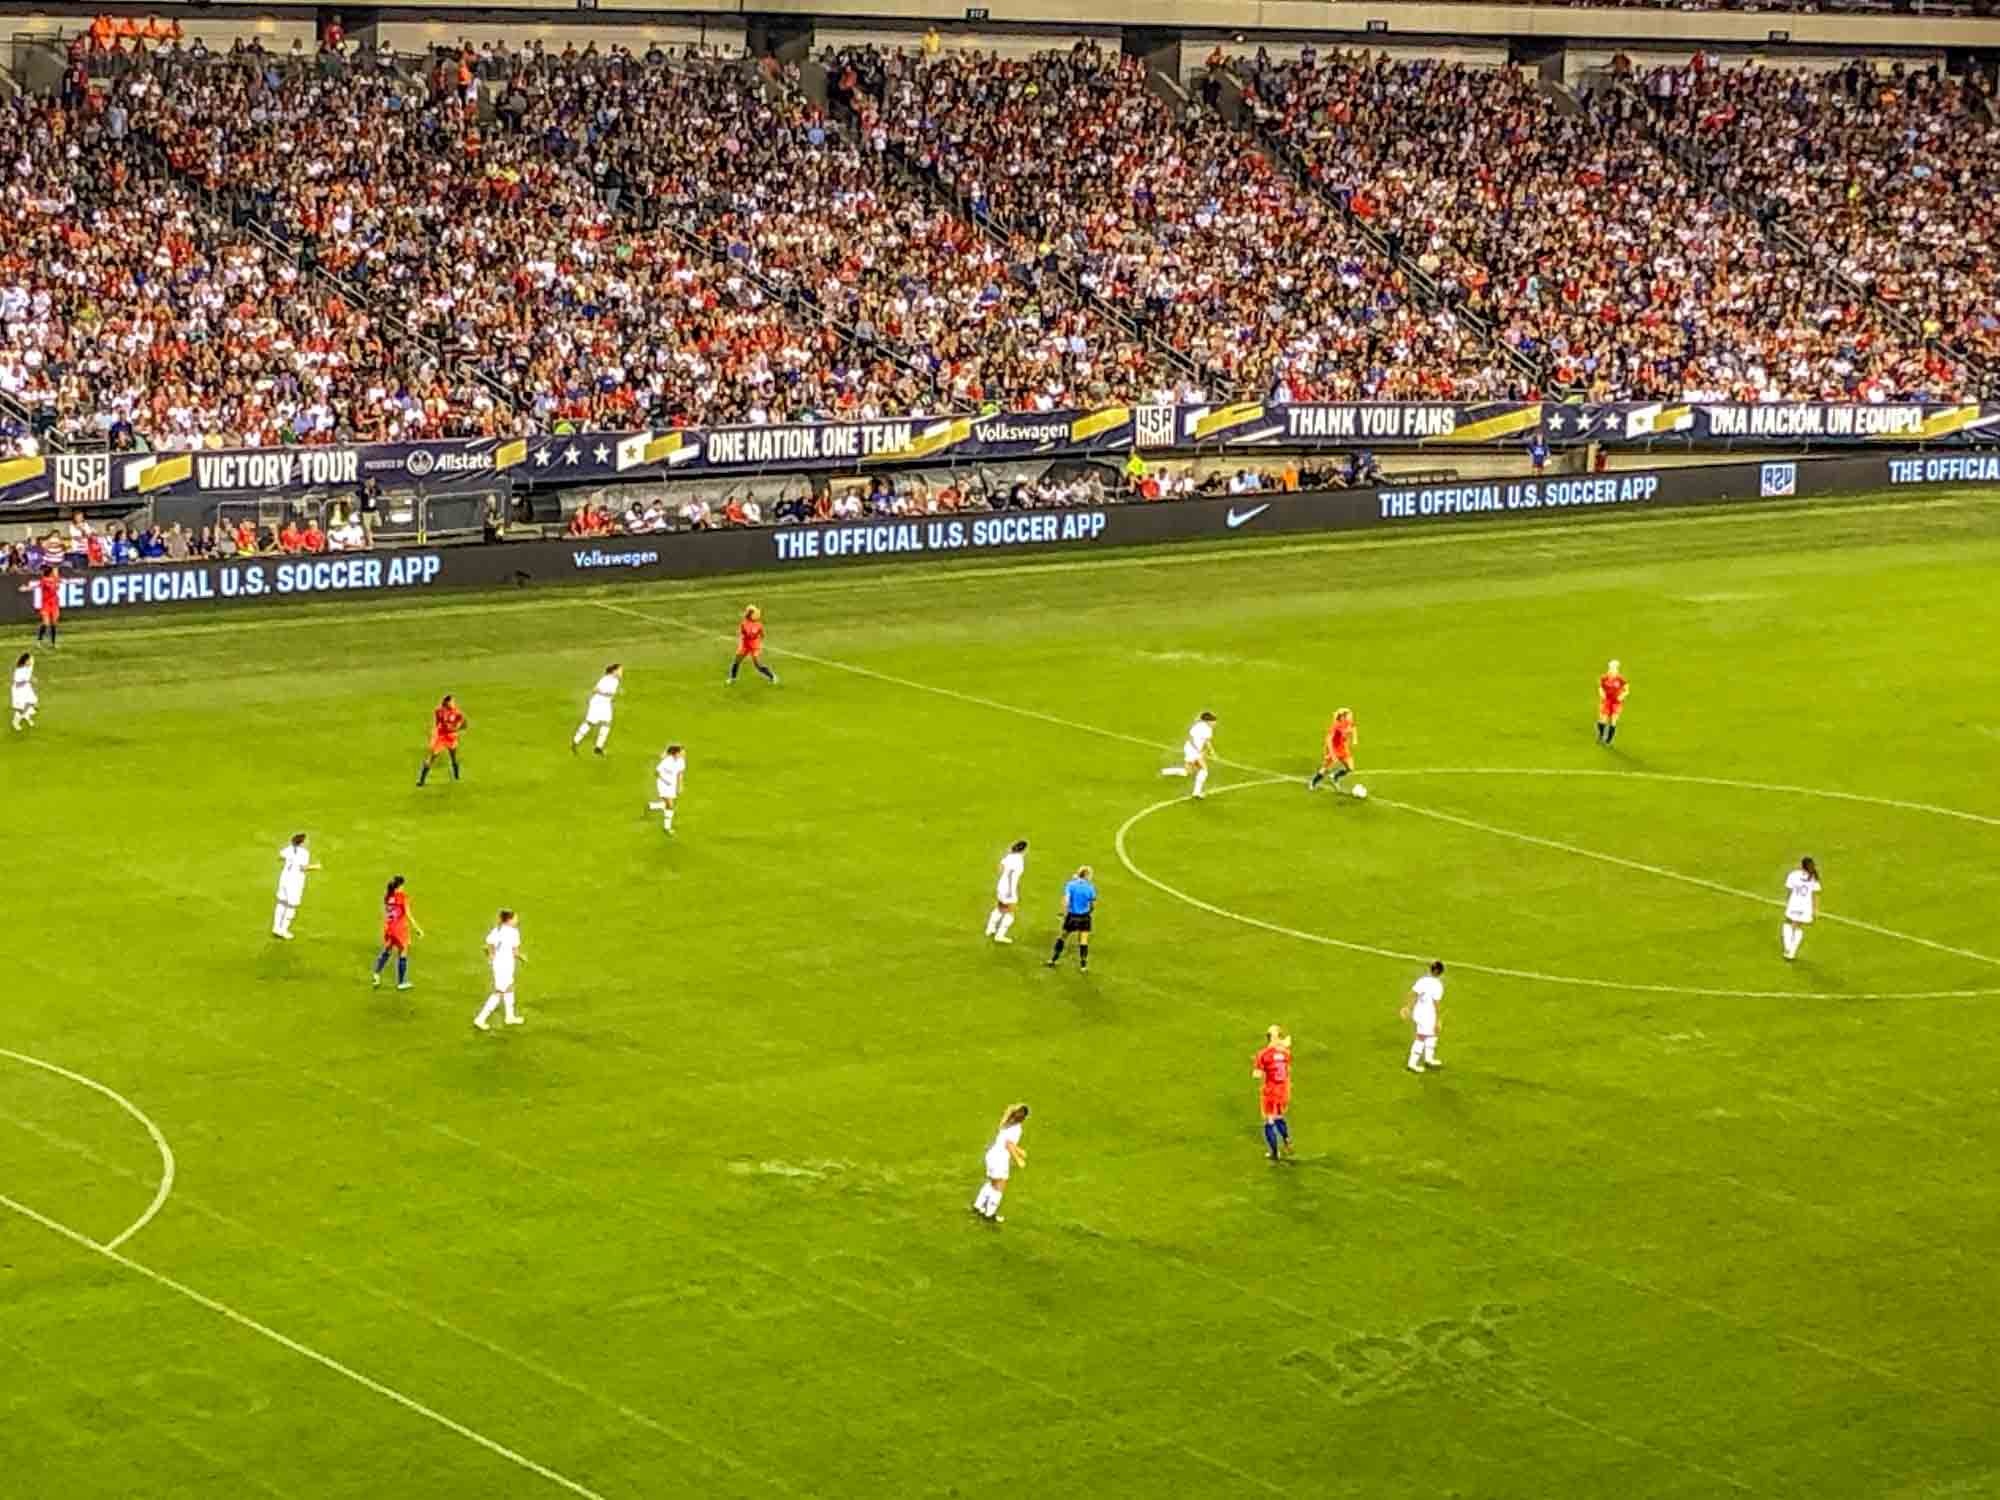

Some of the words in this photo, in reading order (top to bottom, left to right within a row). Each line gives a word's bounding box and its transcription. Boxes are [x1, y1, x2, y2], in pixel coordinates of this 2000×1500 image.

[975, 422, 1069, 443] Volkswagen
[1288, 406, 1356, 436] THANK
[1358, 407, 1402, 435] YOU
[1403, 405, 1456, 435] FANS
[1827, 407, 1854, 433] UN
[708, 430, 749, 463] ONE
[821, 424, 860, 456] ONE
[198, 453, 296, 488] VICTORY
[300, 450, 359, 484] TOUR
[433, 452, 493, 471] Allstate
[1888, 460, 1924, 484] THE
[1378, 491, 1416, 517] THE
[1419, 485, 1503, 514] OFFICIAL
[1507, 483, 1543, 508] U.S.
[1545, 479, 1616, 506] SOCCER
[1619, 476, 1657, 501] APP
[774, 531, 819, 559] THE
[824, 525, 923, 556] OFFICIAL
[927, 522, 968, 549] U.S.
[973, 516, 1058, 546] SOCCER
[1062, 512, 1106, 540] APP
[573, 549, 658, 568] Volkswagen
[91, 568, 214, 606] OFFICIAL
[220, 565, 270, 595] U.S.
[276, 557, 382, 592] SOCCER
[387, 554, 441, 587] APP
